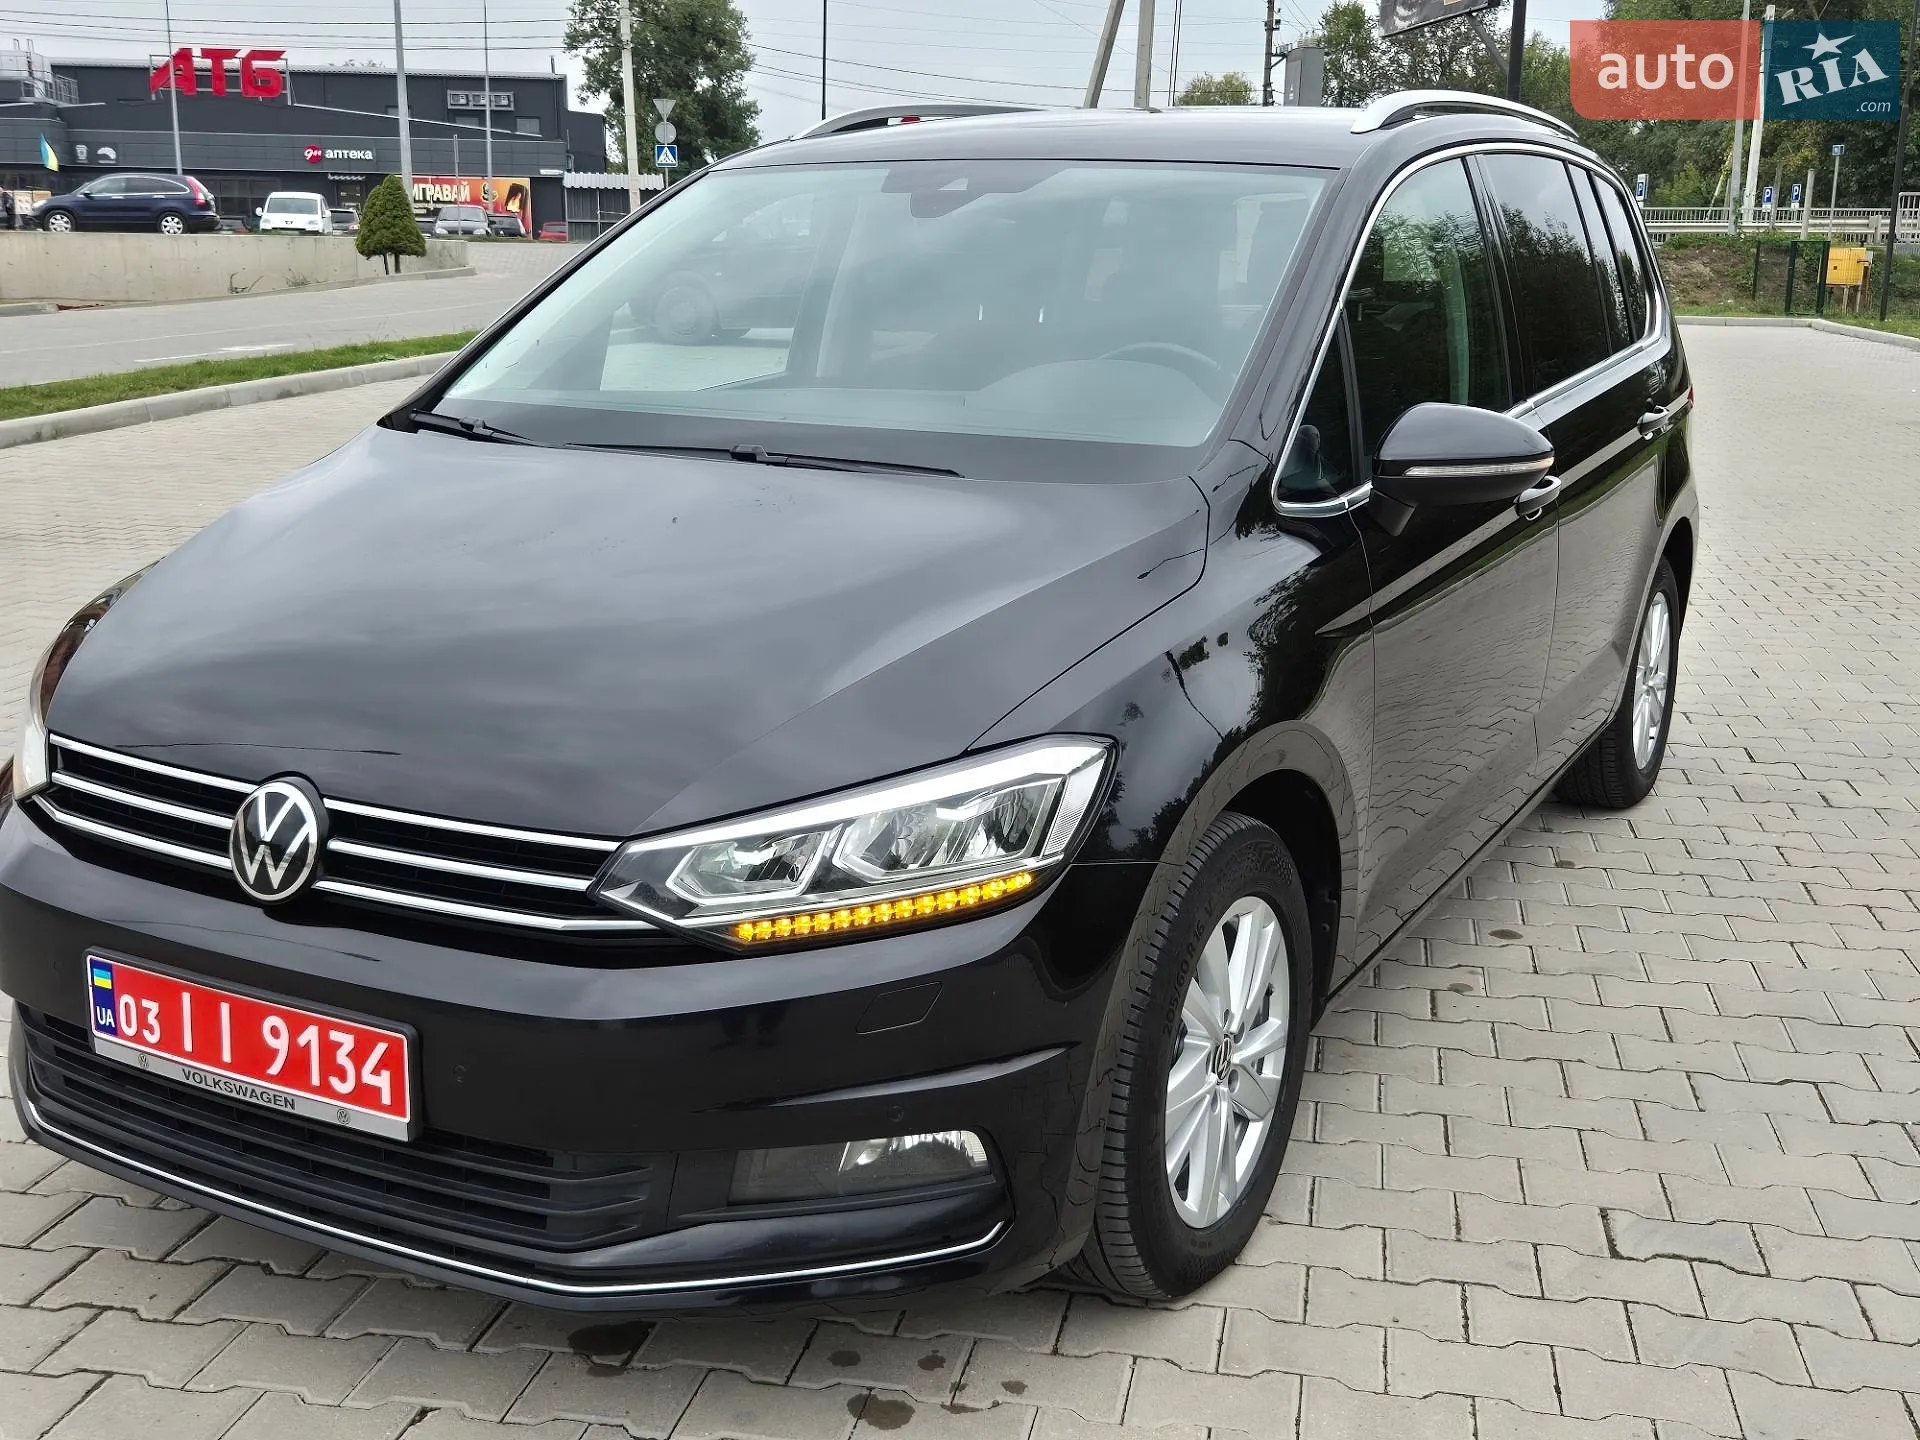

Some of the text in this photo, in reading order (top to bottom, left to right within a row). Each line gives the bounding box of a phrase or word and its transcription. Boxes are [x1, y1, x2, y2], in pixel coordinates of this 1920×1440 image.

[149, 47, 286, 97] АТБ
[325, 149, 373, 160] аптека
[412, 180, 472, 202] ИГРАВАЙ
[96, 1005, 115, 1028] UA
[119, 993, 161, 1044] 03
[261, 1015, 392, 1106] 9134
[182, 1067, 296, 1110] VOLKSWAGEN
